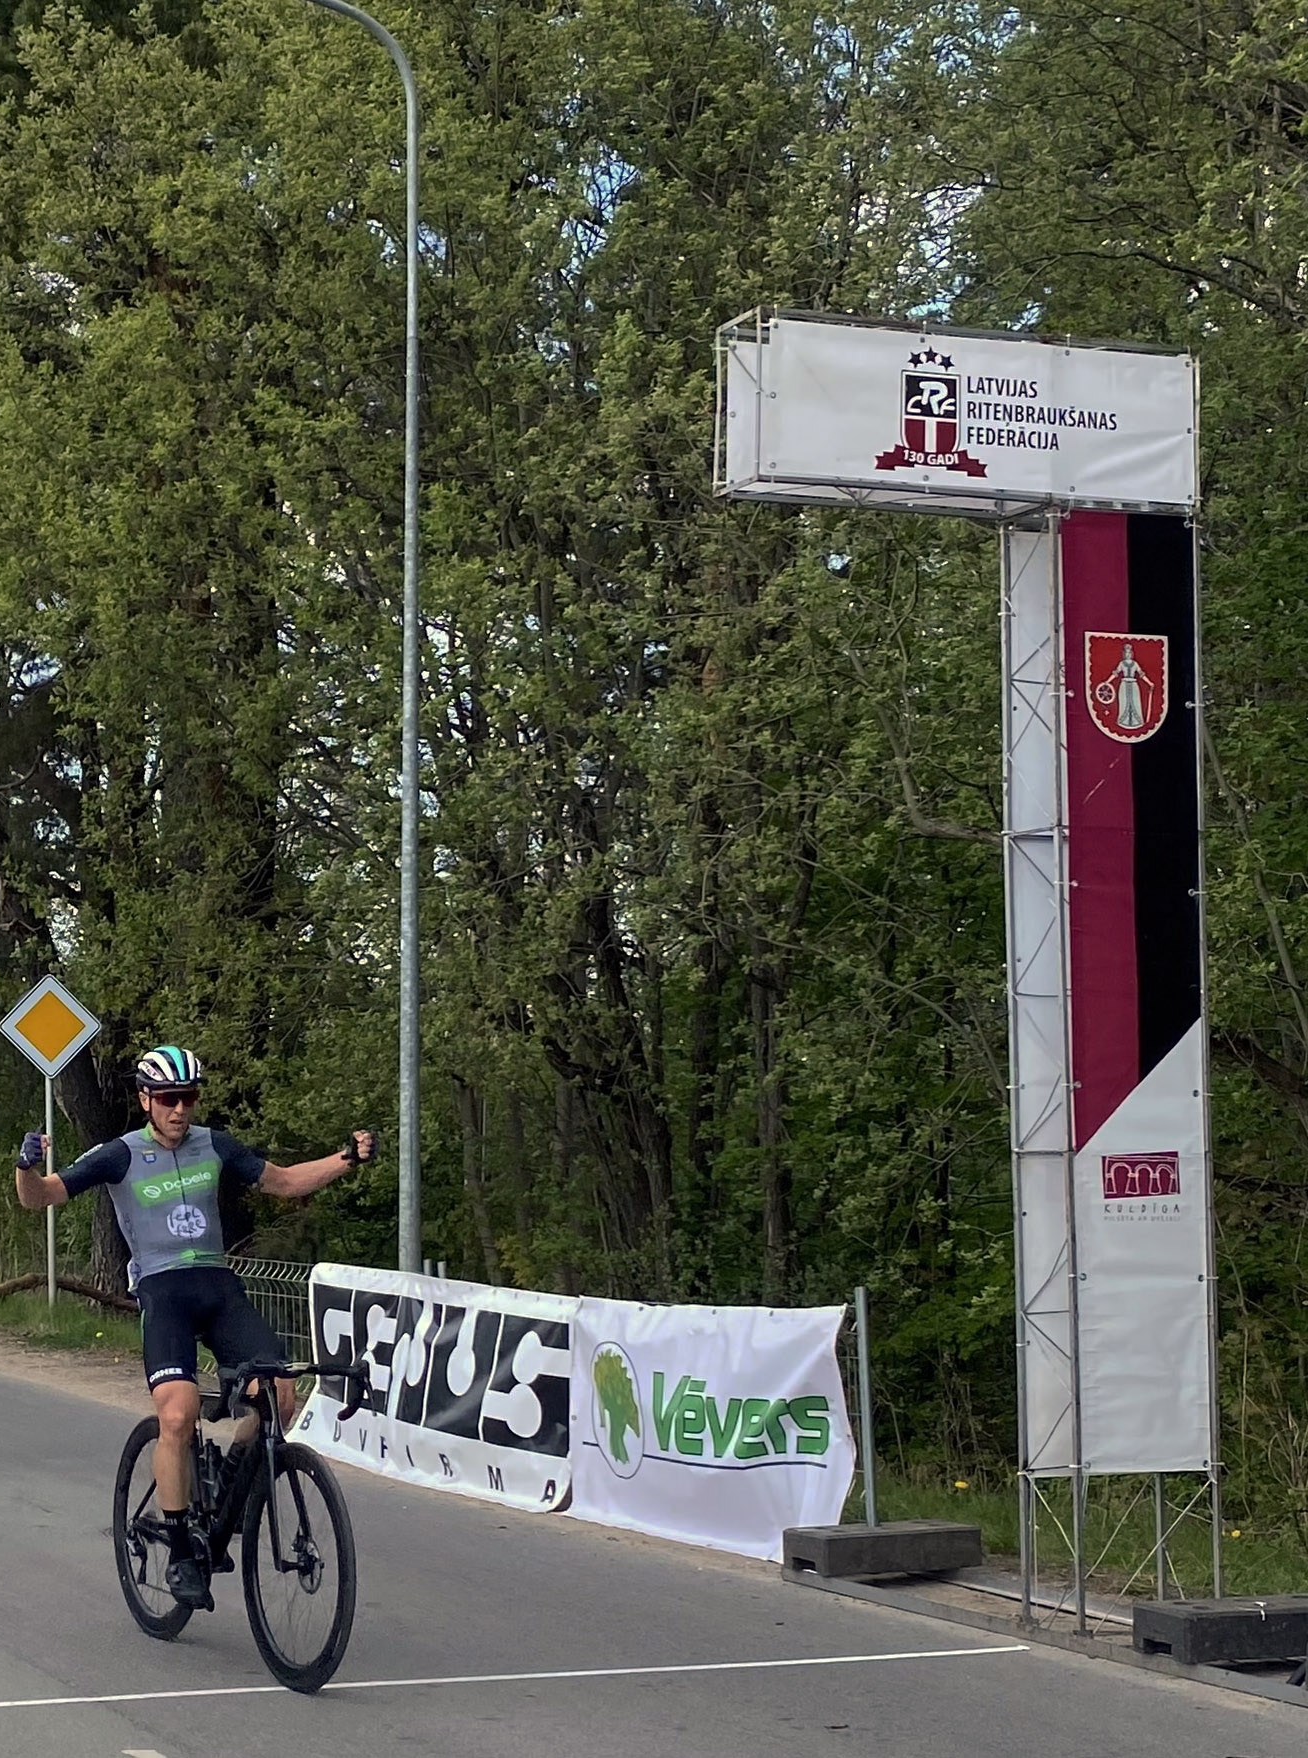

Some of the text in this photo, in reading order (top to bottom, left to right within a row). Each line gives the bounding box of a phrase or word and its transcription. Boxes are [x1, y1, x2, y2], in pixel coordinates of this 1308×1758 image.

[966, 375, 1038, 399] LATVIJAS
[966, 401, 1117, 431] RITEŅBRAUKŠANAS
[966, 425, 1060, 450] FEDERĀCIJA
[903, 449, 959, 465] 130 GADI
[162, 1171, 212, 1192] Dobele
[1103, 1202, 1181, 1214] KULDĪGA
[149, 1367, 183, 1383] OSHEE
[652, 1371, 831, 1460] Vēvers
